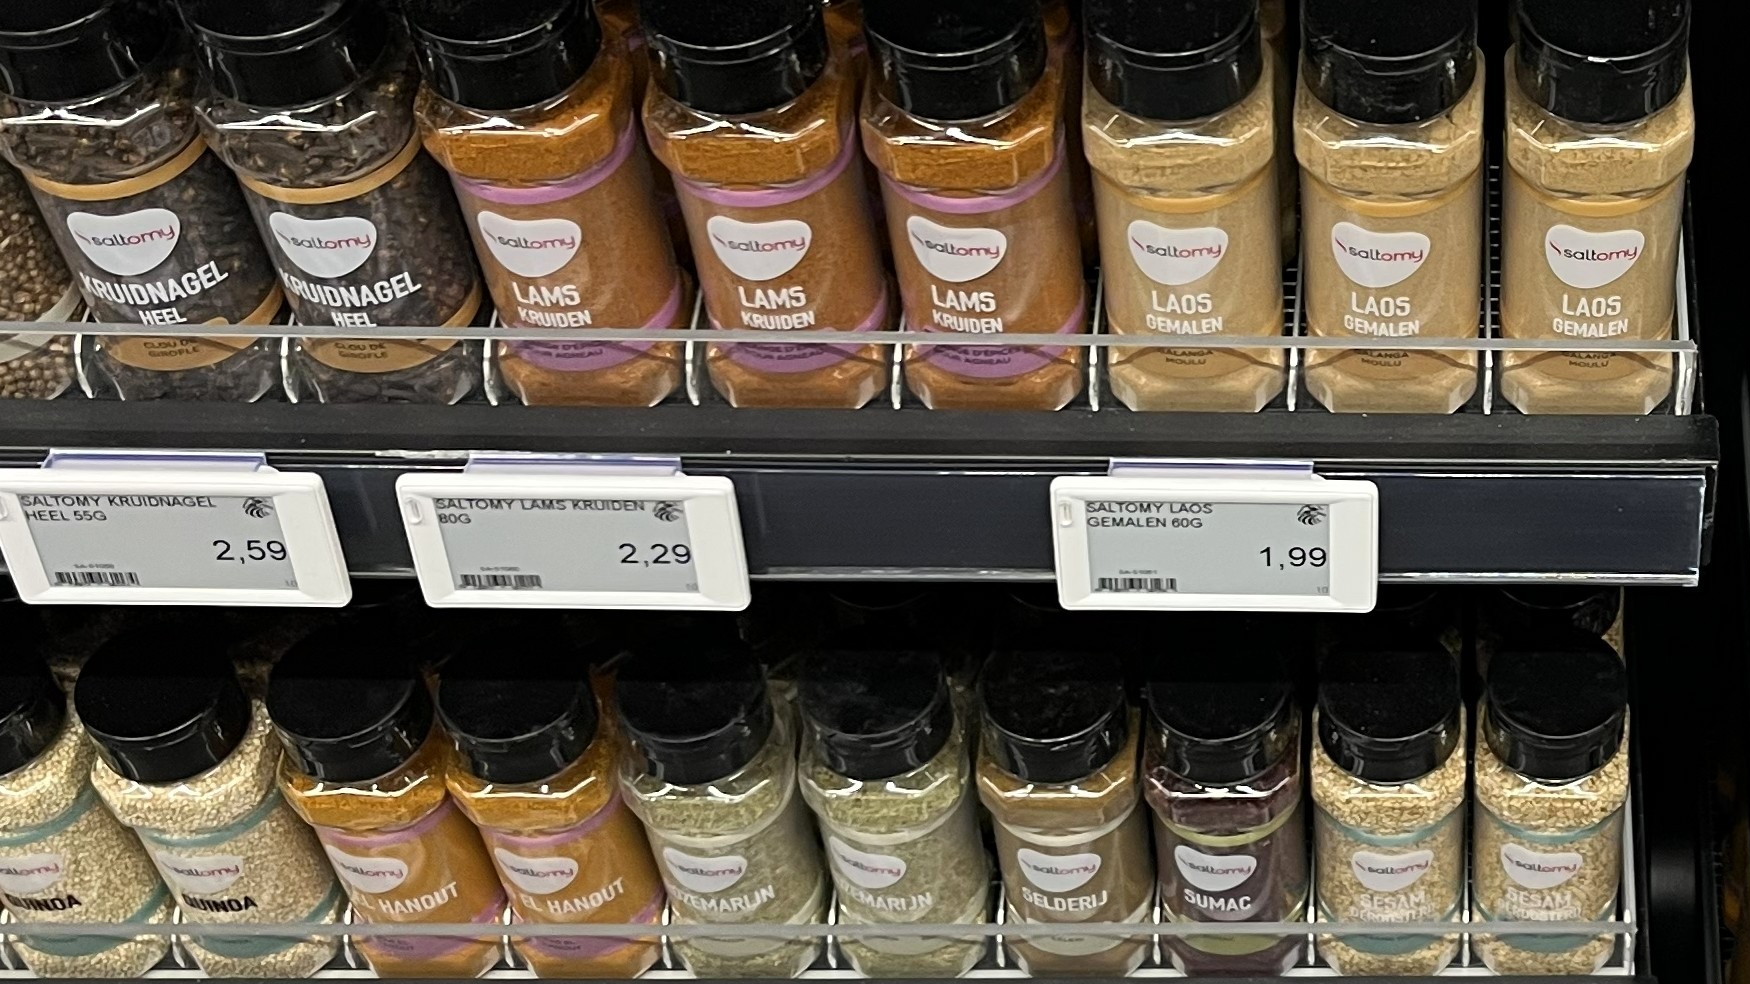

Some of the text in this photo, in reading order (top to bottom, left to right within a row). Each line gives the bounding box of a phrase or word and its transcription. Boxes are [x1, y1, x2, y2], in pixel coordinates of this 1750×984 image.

[91, 225, 176, 246] saltomy
[291, 232, 372, 249] saltomy
[498, 234, 576, 251] saltomy
[723, 234, 806, 253] saltomy
[925, 240, 1000, 259] saltomy
[1145, 243, 1222, 260] saltomy
[1348, 245, 1424, 263] saltomy
[1564, 245, 1638, 262] saltomy
[79, 261, 228, 306] KRUIDNAGEL
[278, 267, 421, 308] KRUIDNAGEL
[512, 282, 581, 307] LAMS
[737, 286, 807, 310] LAMS
[931, 285, 996, 312] LAMS
[1151, 290, 1212, 314] LAOS
[1351, 292, 1410, 317] LAOS
[139, 307, 187, 326] HEEL
[517, 305, 592, 328] KRUIDEN
[1563, 294, 1622, 318] LAOS
[331, 312, 377, 328] HEEL
[741, 309, 815, 330] KRUIDEN
[932, 308, 1004, 333] KRUIDEN
[1146, 313, 1222, 335] GEMALEN
[1344, 315, 1420, 337] GEMALEN
[1553, 318, 1628, 338] GEMALEN
[20, 496, 217, 509] SALTOMY KRUIDNAGEL
[435, 499, 645, 511] SALTOMY LAMS KRUIDEN
[1086, 502, 1213, 514] SALTOMY LAOS
[25, 510, 107, 521] HEEL 55G
[438, 513, 471, 524] 80G
[1086, 517, 1203, 528] GEMALEN 60G
[212, 539, 288, 564] 2,59
[618, 543, 692, 568] 2,29
[1259, 547, 1327, 570] 1,99
[1031, 862, 1096, 876] saltomy
[1186, 862, 1251, 876] saltomy
[378, 881, 459, 914] HANOUT
[547, 877, 624, 914] HANOUT
[1022, 886, 1108, 911] SELDERIJ
[1184, 889, 1251, 911] SUMAC
[1360, 890, 1426, 909] SESAM
[1507, 887, 1571, 907] SESAM
